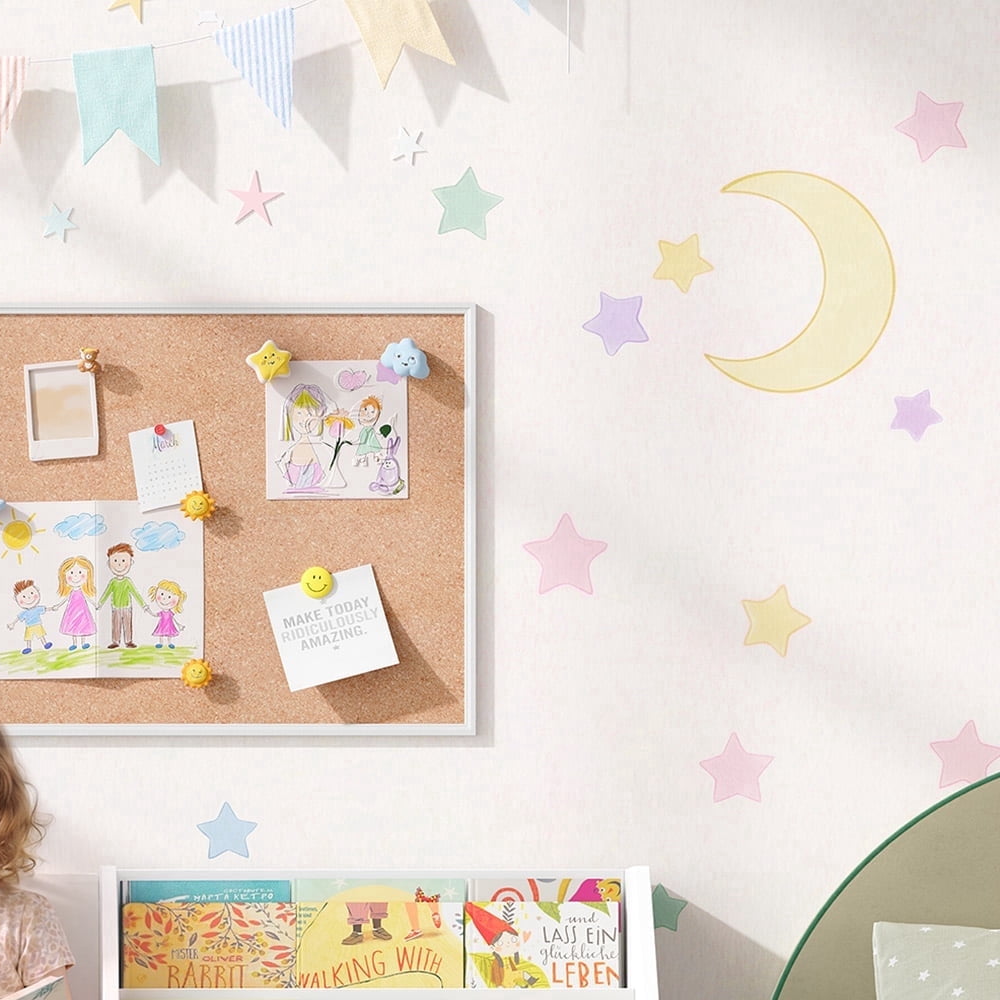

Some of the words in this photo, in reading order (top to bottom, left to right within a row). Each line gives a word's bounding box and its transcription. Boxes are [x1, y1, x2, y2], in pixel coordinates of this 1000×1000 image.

[281, 607, 378, 642] RIDICULOUSLY
[283, 609, 323, 629] MAKE
[325, 596, 369, 617] TODAY
[301, 625, 367, 651] AMAZING.
[543, 925, 577, 944] LASS
[171, 948, 199, 960] MISTER
[396, 945, 443, 974] WITH
[552, 961, 620, 988] LEBEN
